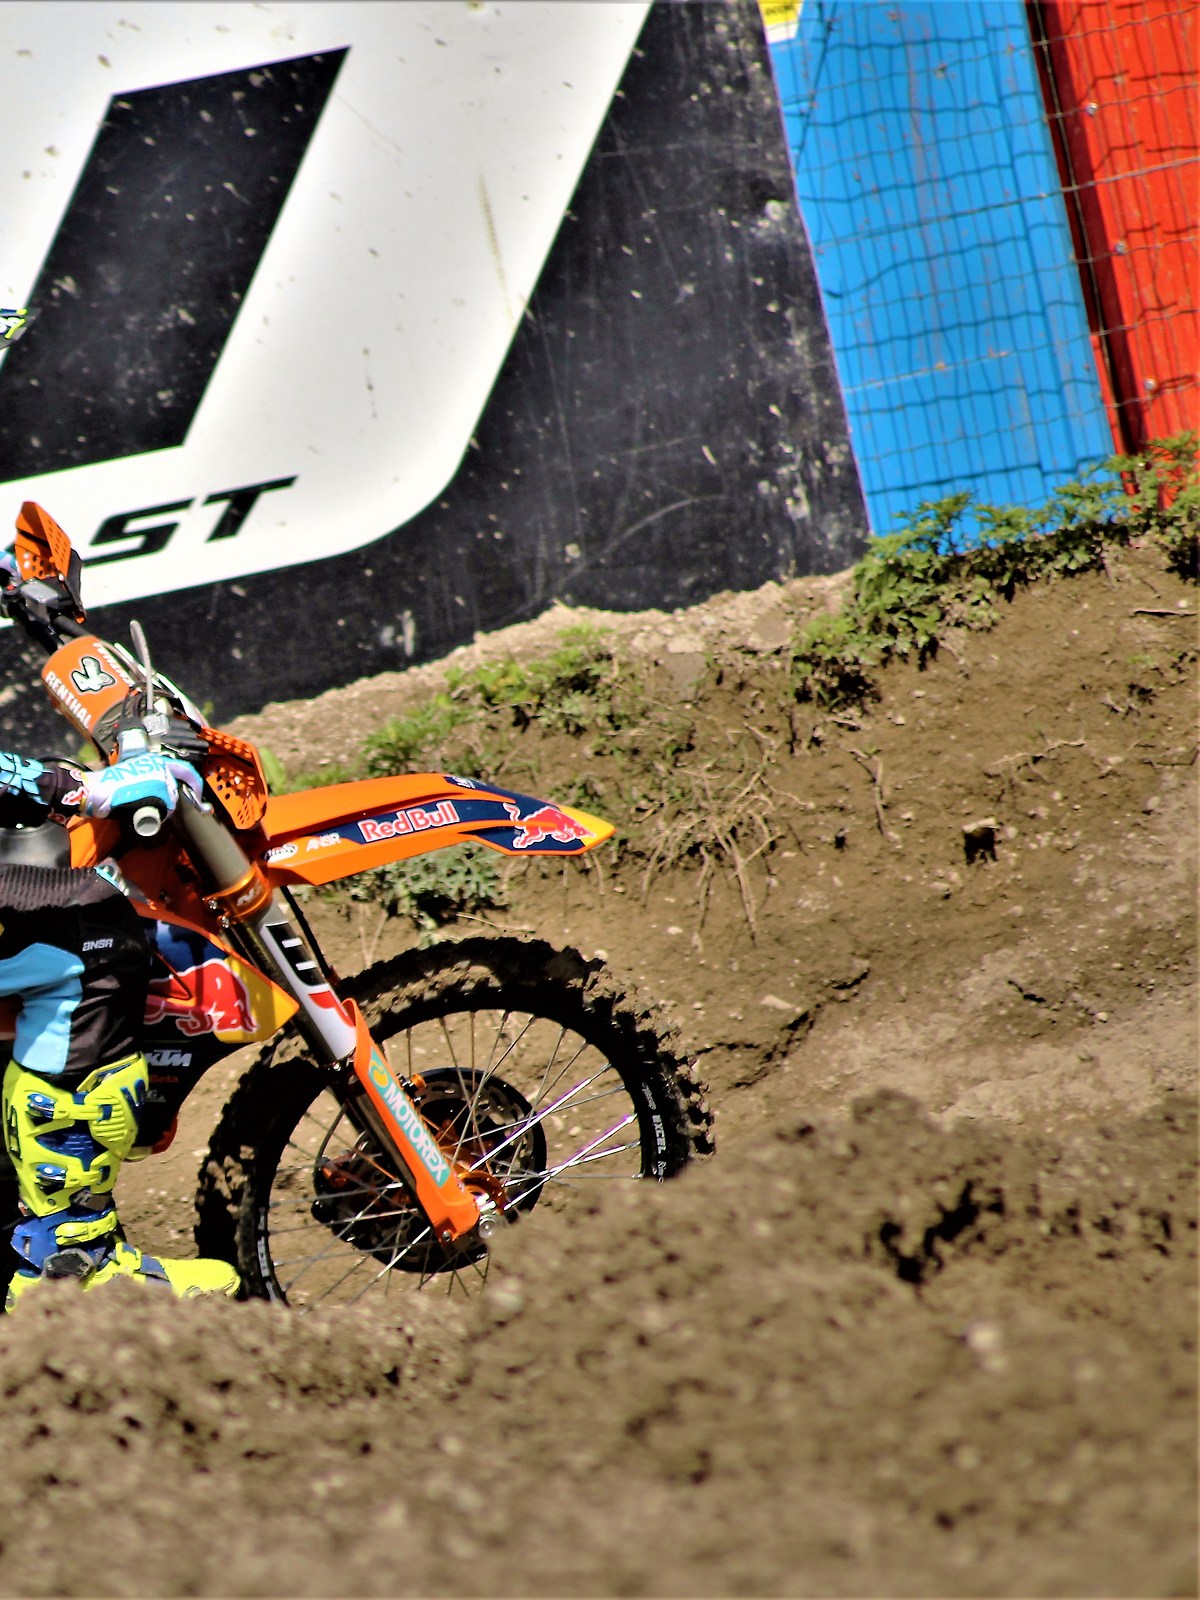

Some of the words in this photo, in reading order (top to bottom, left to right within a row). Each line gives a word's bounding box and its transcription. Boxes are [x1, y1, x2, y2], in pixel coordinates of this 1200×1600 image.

[81, 473, 299, 569] ST
[43, 670, 93, 728] RENTHAL
[358, 810, 413, 842] Red
[406, 800, 460, 831] Bull
[147, 1049, 193, 1067] KTM
[383, 1082, 445, 1184] MOTOREX
